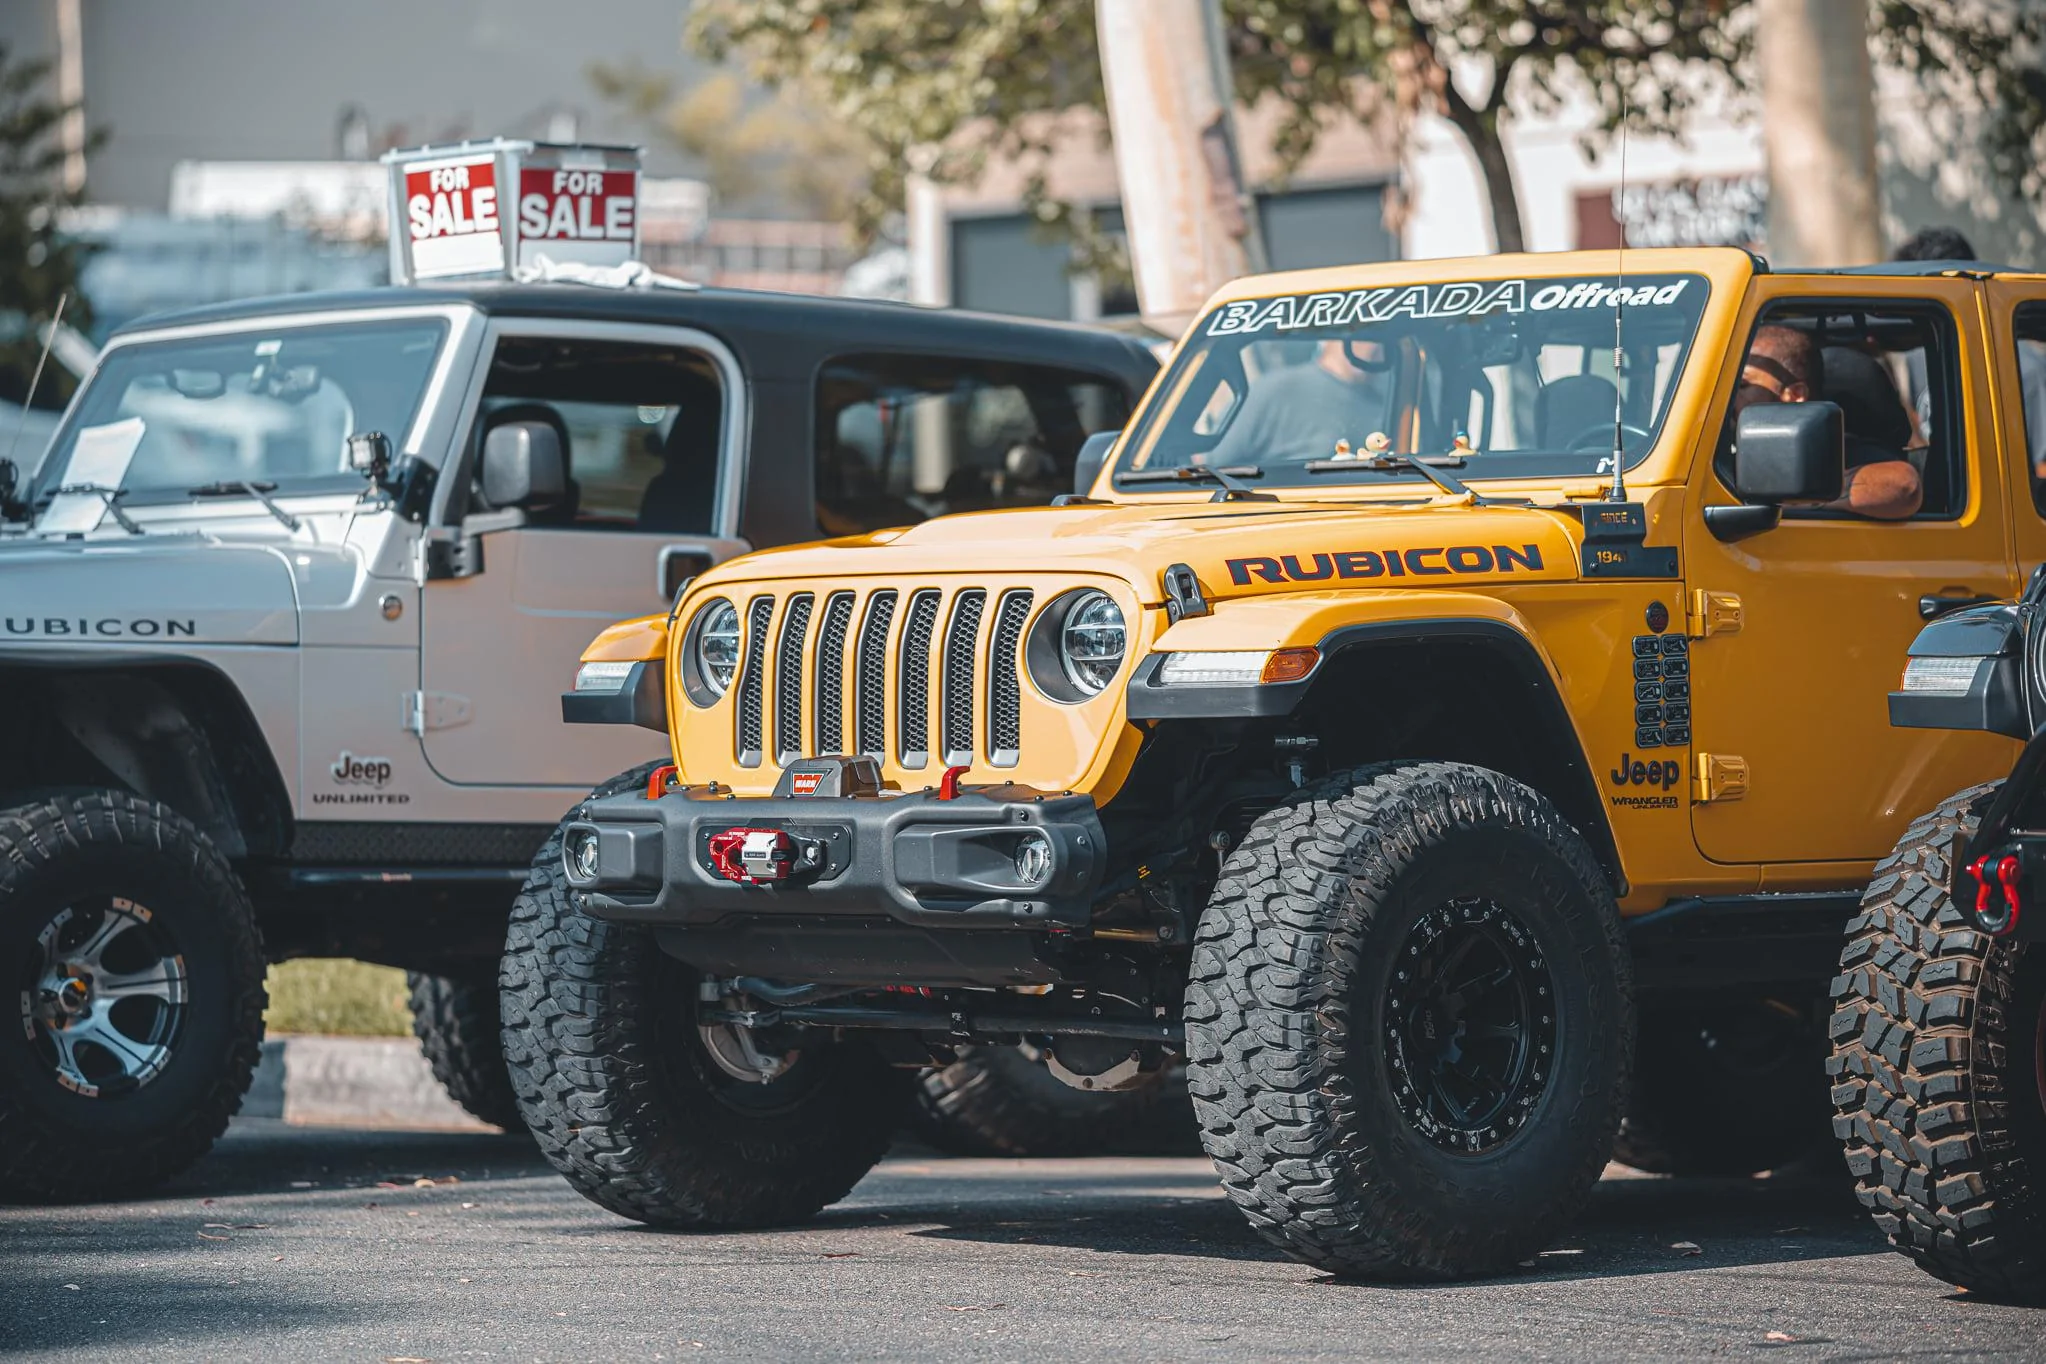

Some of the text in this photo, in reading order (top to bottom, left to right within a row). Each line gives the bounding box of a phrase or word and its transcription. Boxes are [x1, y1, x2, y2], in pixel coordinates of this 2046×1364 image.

[430, 167, 469, 193] FOR
[553, 171, 603, 195] FOR
[409, 186, 498, 239] SALE
[520, 193, 635, 239] SALE
[1207, 279, 1689, 336] BARKADA Offroad
[1225, 544, 1544, 586] RUBICON
[334, 755, 391, 785] Jeep
[1611, 753, 1679, 792] Jeep
[313, 794, 410, 804] UNLIMITED
[1612, 796, 1678, 805] WRANGLER
